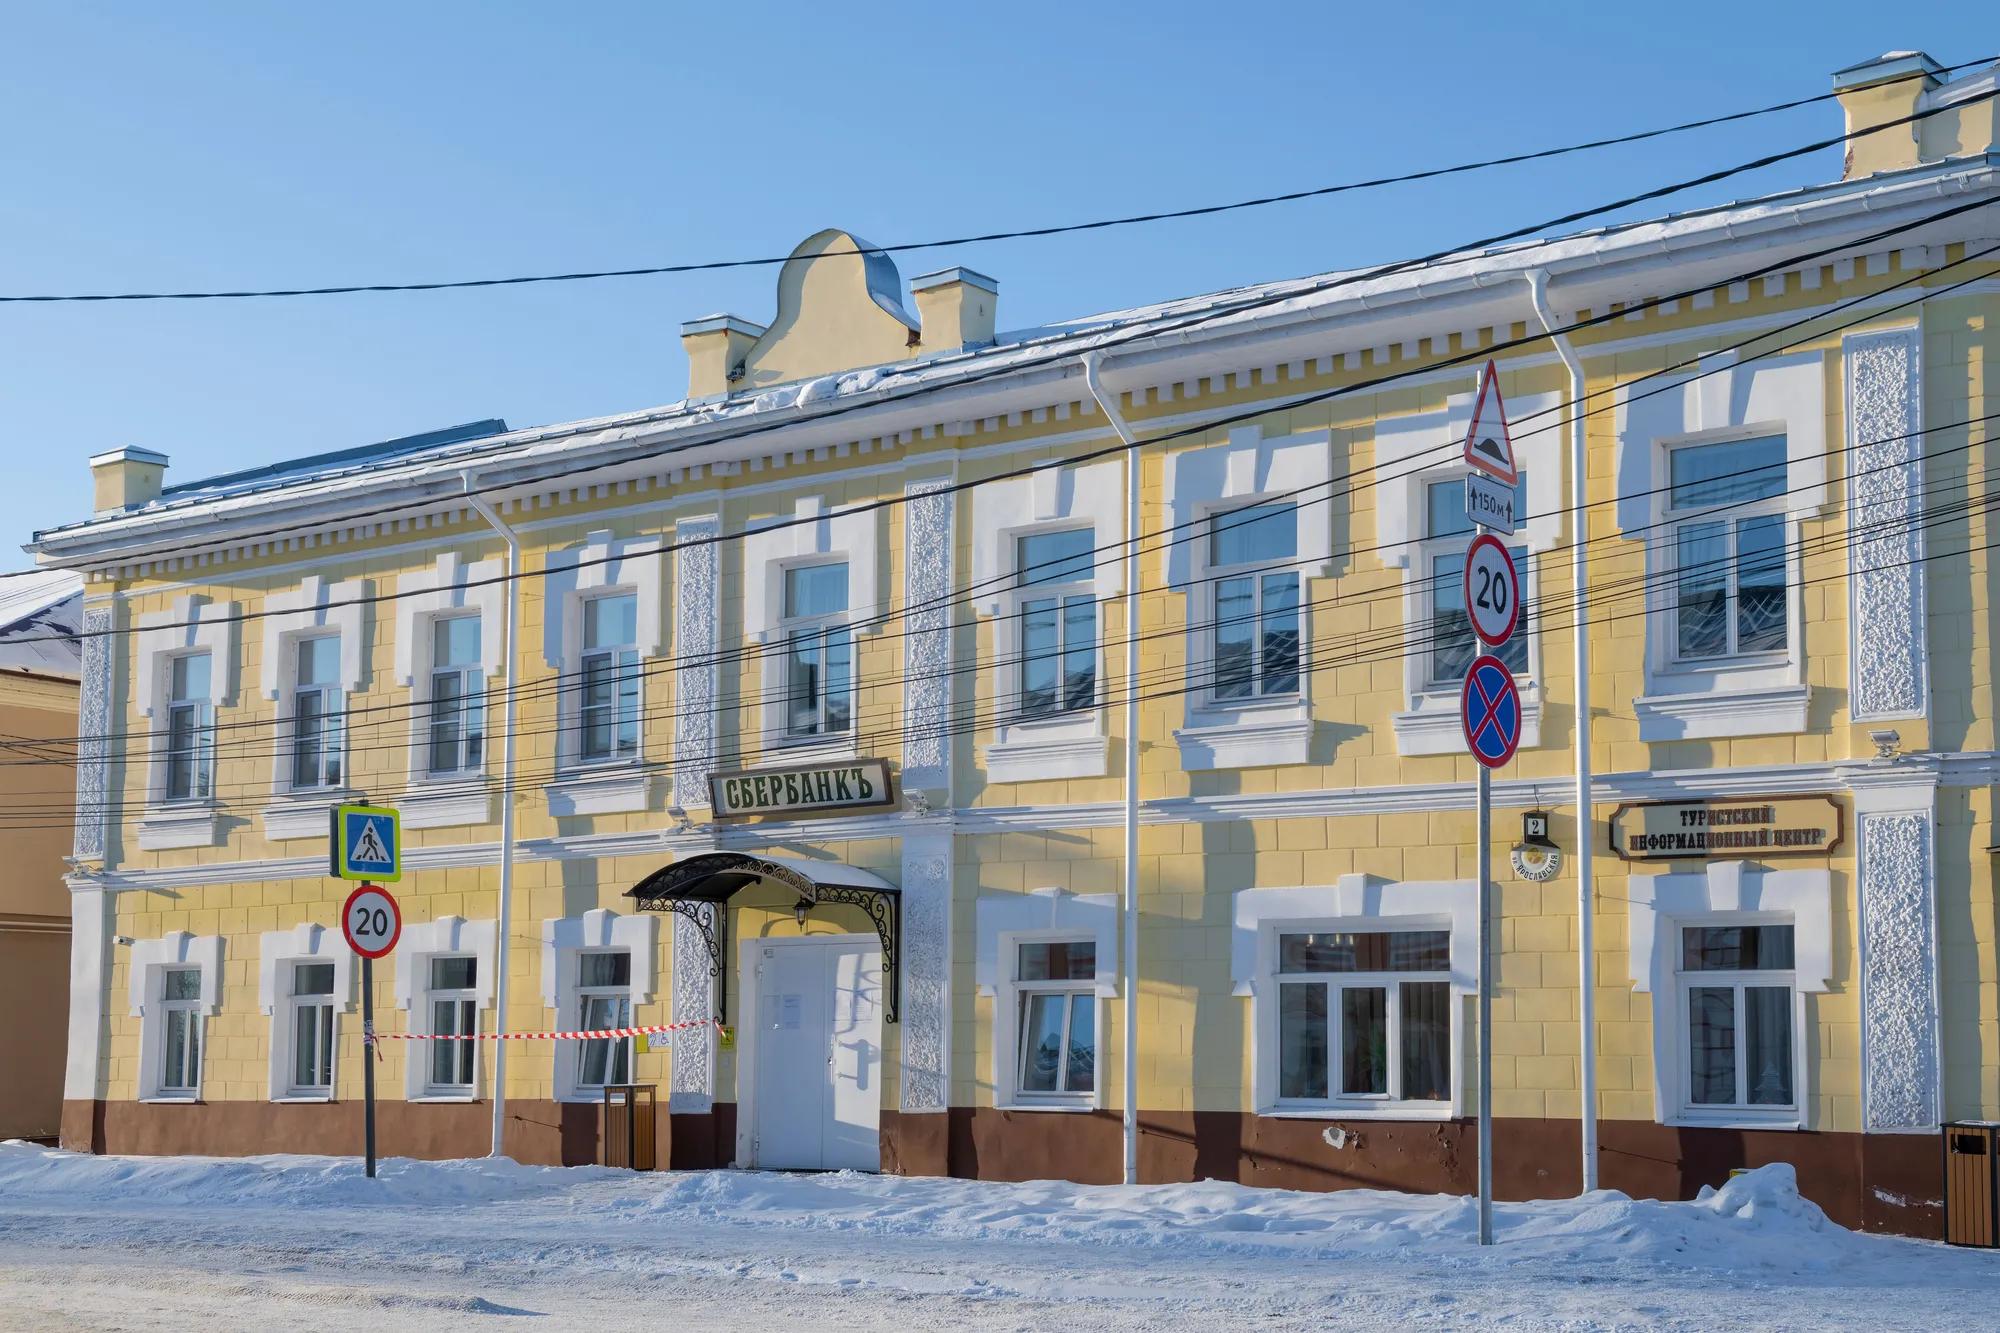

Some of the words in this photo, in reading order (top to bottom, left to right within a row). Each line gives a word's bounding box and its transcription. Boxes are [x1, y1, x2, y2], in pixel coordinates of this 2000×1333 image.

[1477, 565, 1507, 614] 20
[725, 768, 873, 809] СБЕРБАНКЪ
[1532, 820, 1539, 834] 2
[1680, 805, 1771, 826] ТУРИСТСКИЙ
[1629, 828, 1769, 851] ИНФОРМАЦИОННЫЙ
[1773, 828, 1821, 847] ЦЕНТР
[1516, 854, 1558, 880] ЯРОСЛАВСКАЯ
[356, 908, 388, 936] 20
